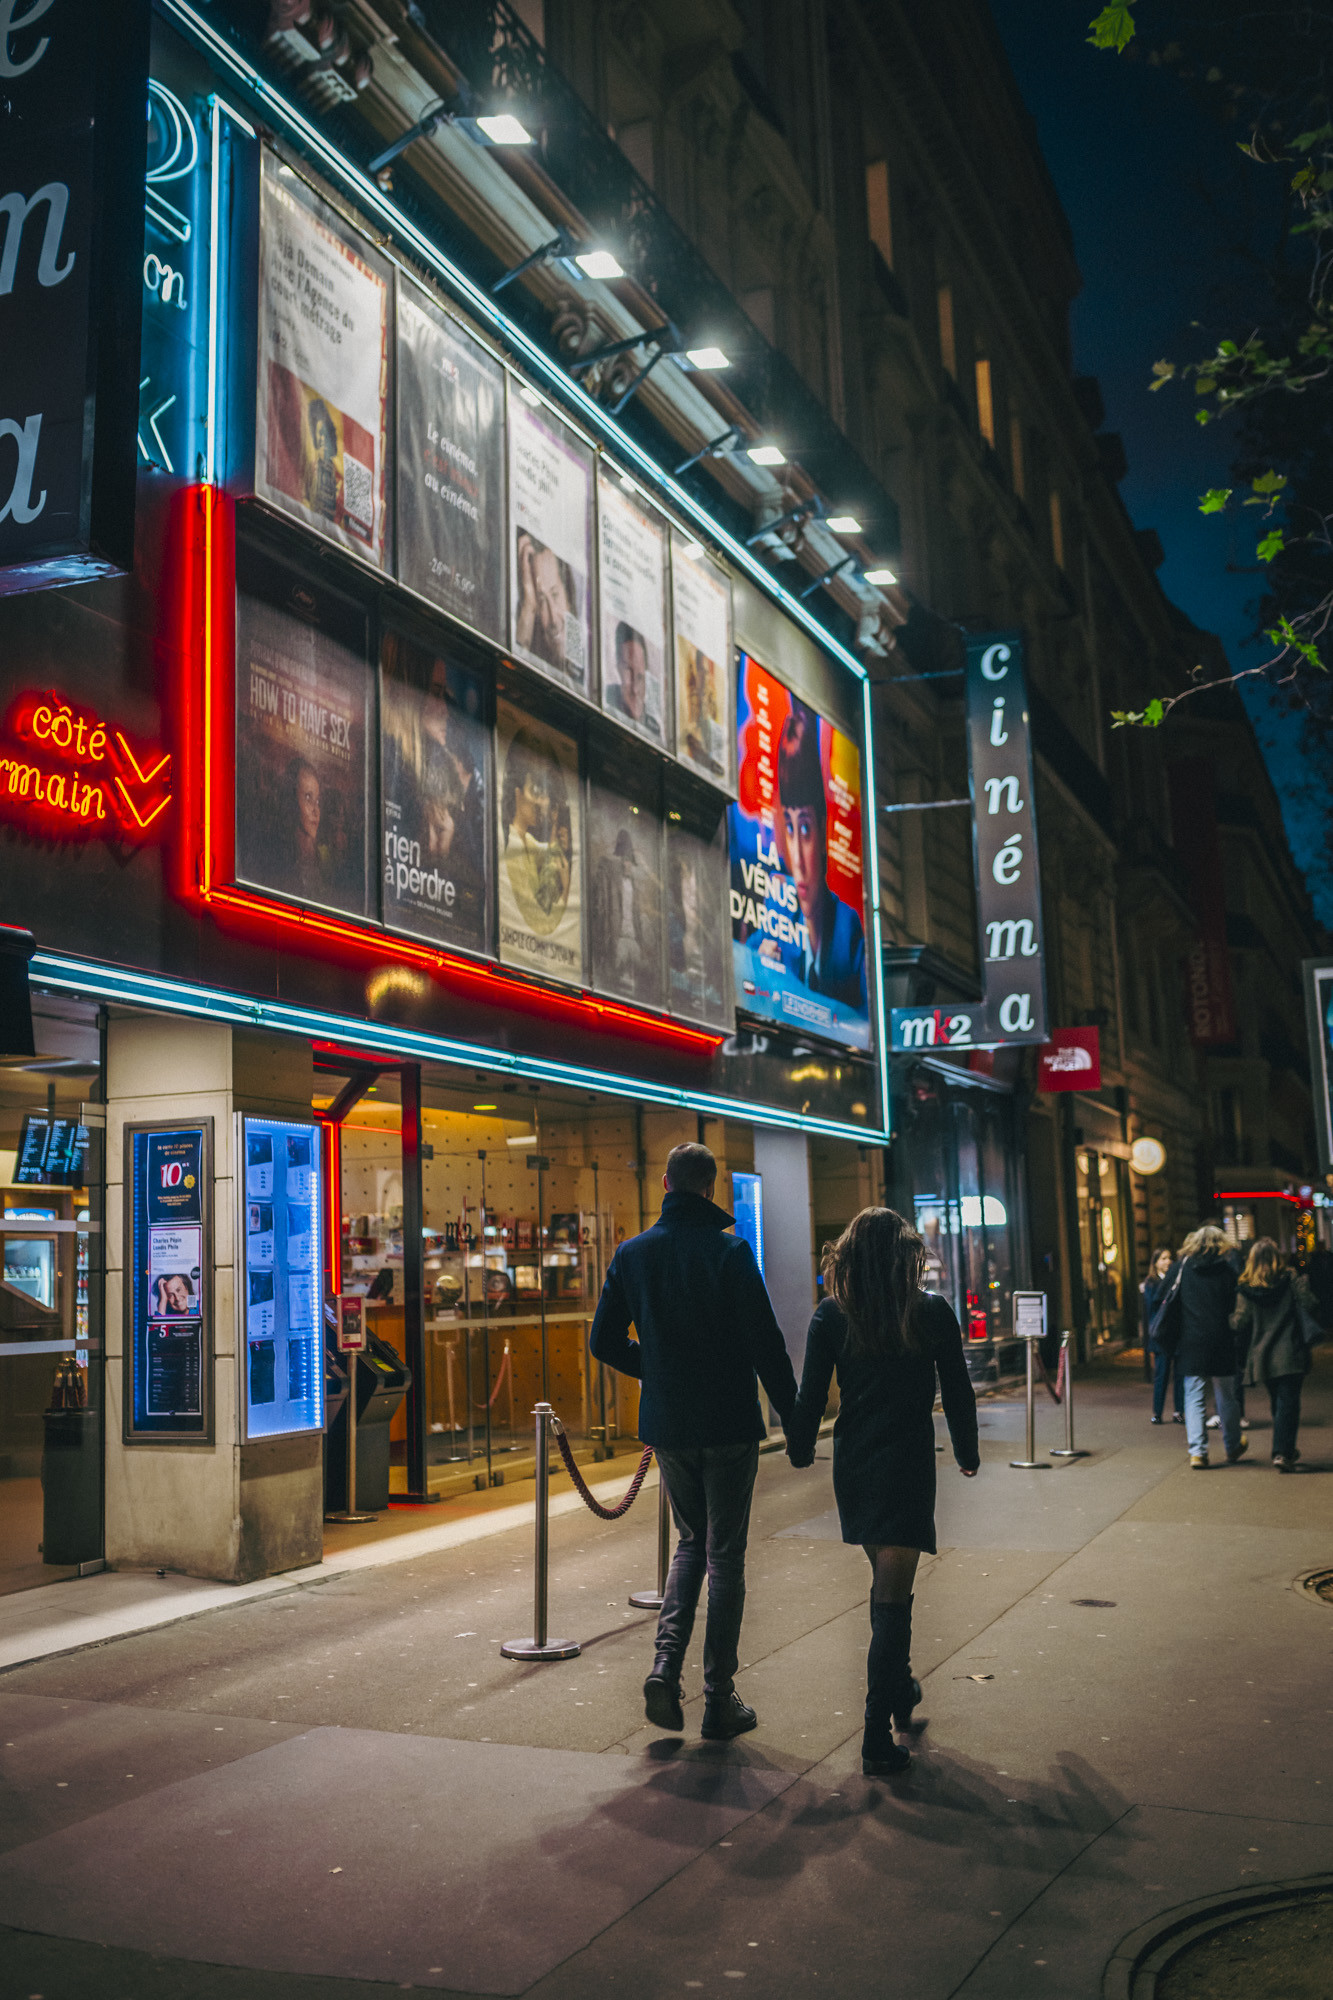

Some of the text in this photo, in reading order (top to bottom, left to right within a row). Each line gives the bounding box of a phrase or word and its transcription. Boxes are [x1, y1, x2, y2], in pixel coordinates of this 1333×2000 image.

[427, 422, 439, 445] Le
[425, 472, 439, 493] au
[32, 705, 106, 761] côté
[249, 673, 279, 716] HOW
[281, 690, 297, 725] TO
[298, 697, 327, 740] HAVE
[329, 713, 351, 751] SEX
[384, 824, 420, 868] rien
[756, 833, 782, 872] LA
[980, 642, 1038, 1033] cinéma
[383, 857, 456, 907] à perdre
[740, 858, 799, 913] VÉNUS
[729, 889, 809, 952] D'ARGENT
[899, 1008, 972, 1048] mk2
[161, 1162, 183, 1188] 10
[159, 1324, 167, 1338] 5
